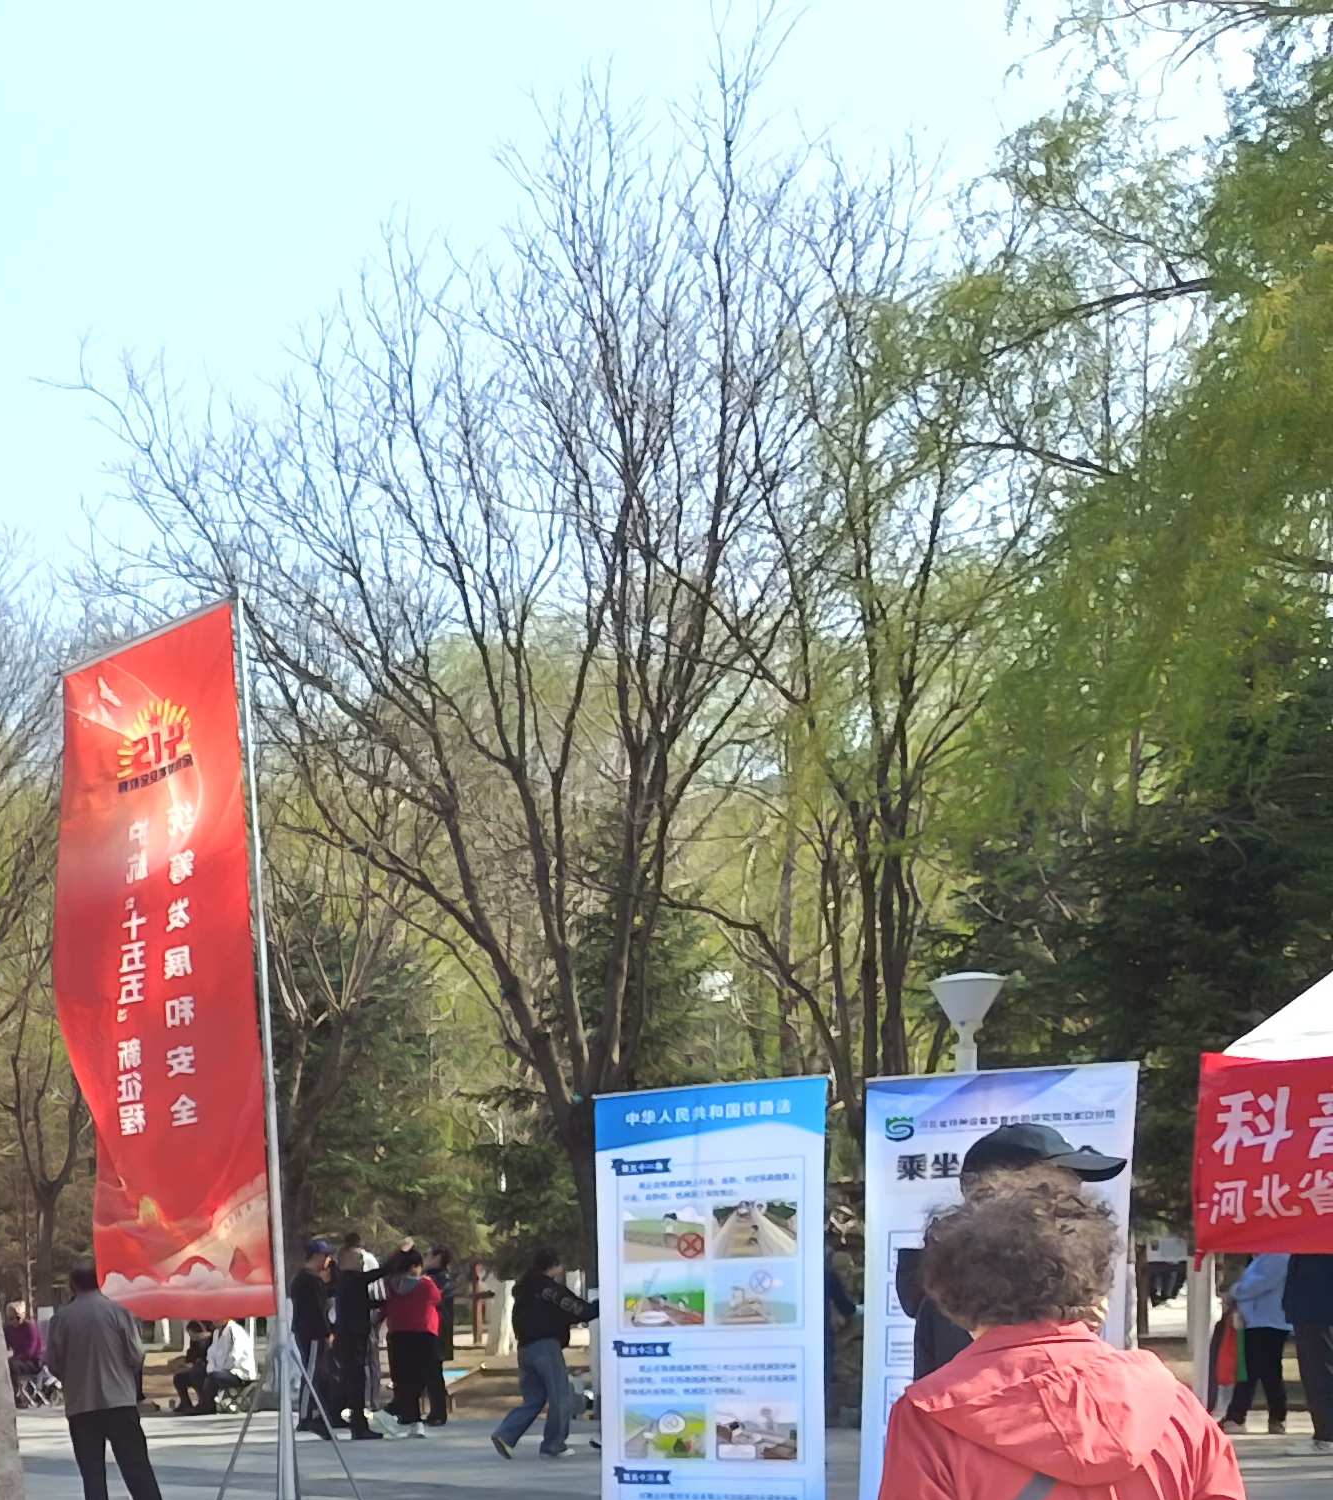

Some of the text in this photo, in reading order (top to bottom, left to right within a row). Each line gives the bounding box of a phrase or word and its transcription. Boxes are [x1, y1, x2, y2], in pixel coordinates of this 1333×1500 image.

[896, 1151, 960, 1181] 乘坐
[1209, 1169, 1333, 1225] 河北省
